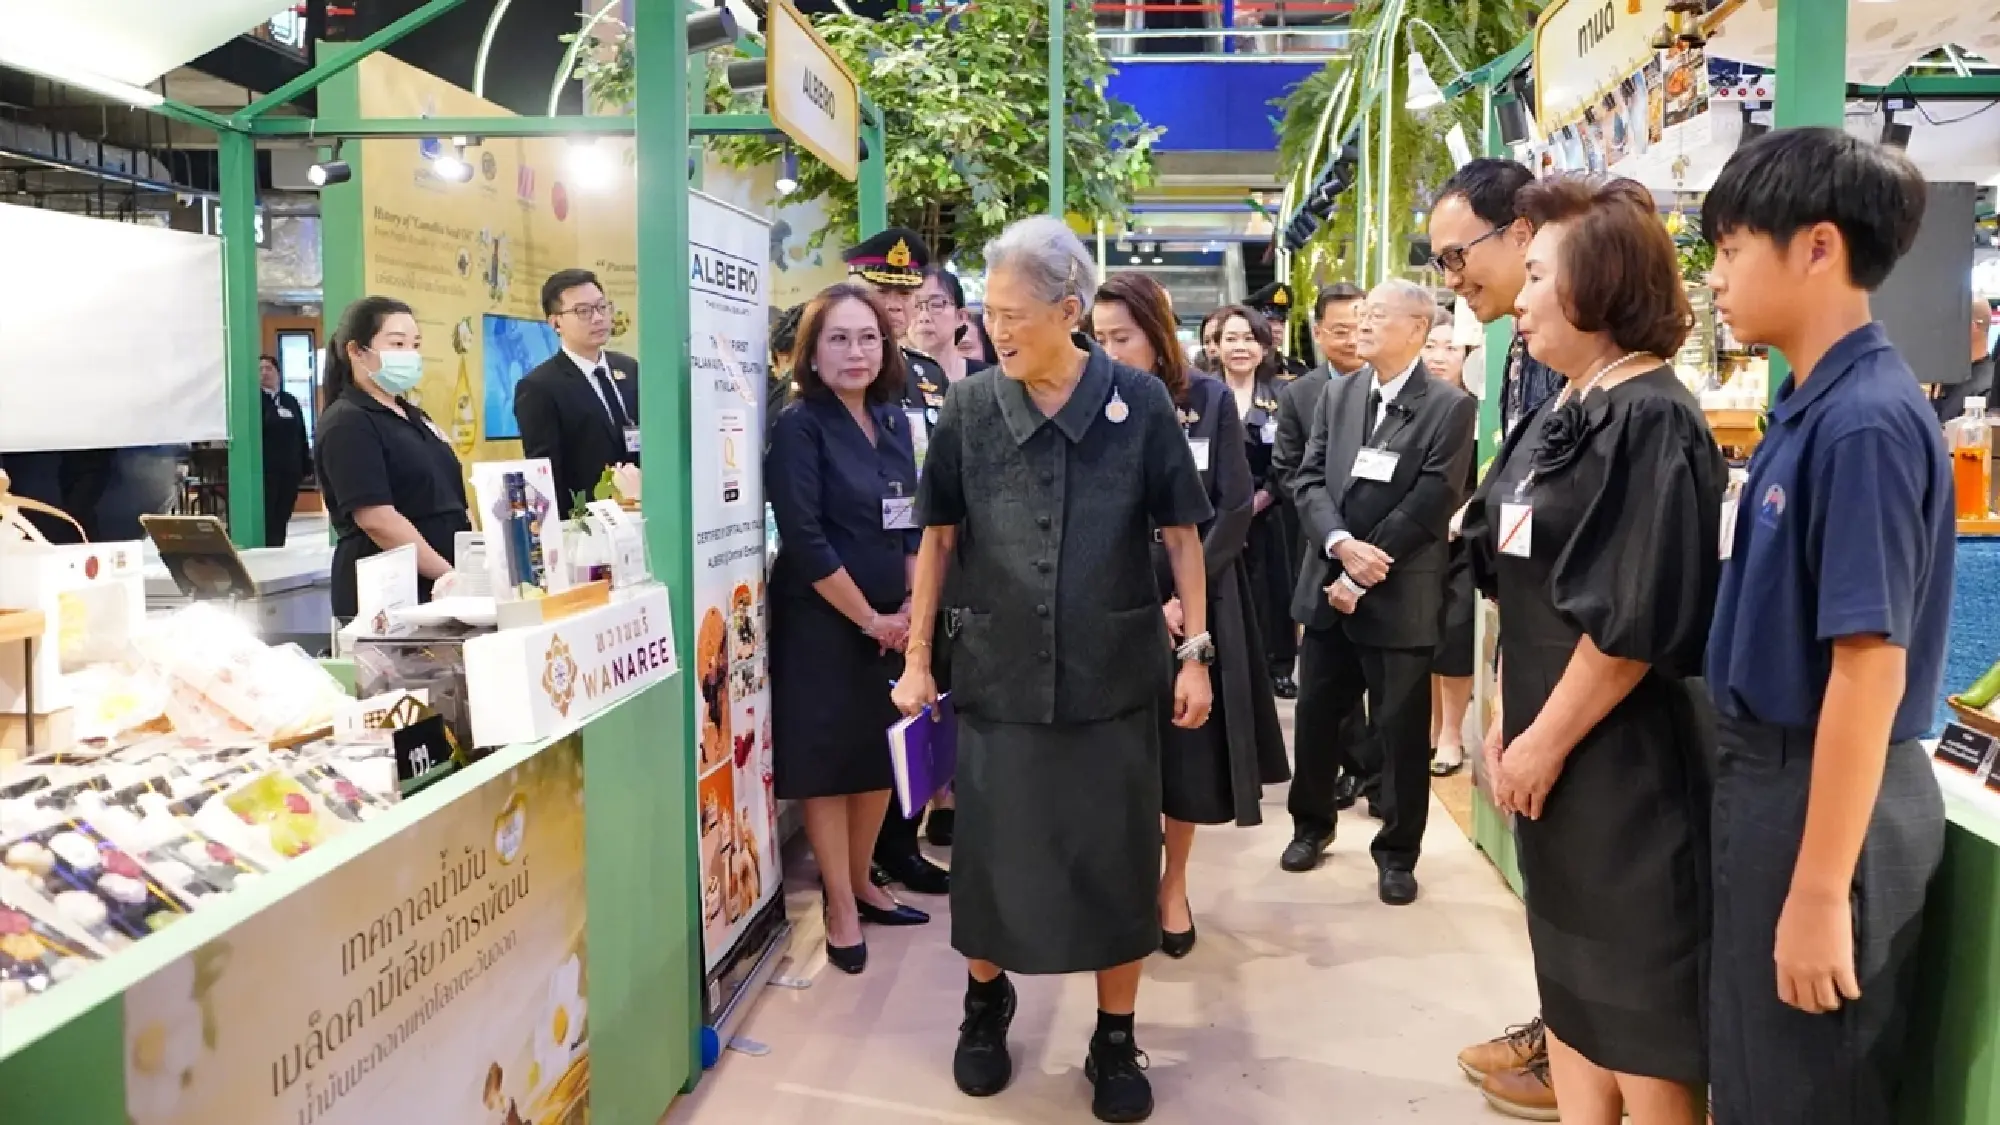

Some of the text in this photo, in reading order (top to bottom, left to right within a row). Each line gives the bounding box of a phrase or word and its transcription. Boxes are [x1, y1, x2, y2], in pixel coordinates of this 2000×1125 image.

[803, 67, 835, 119] ALBERO
[692, 253, 758, 296] ALBERO
[582, 636, 669, 700] WANAREE
[342, 845, 487, 977] เทศกาลน้ำมัน
[271, 853, 530, 1098] เมล็ดคามีเลีย ภัทรพัฒน์
